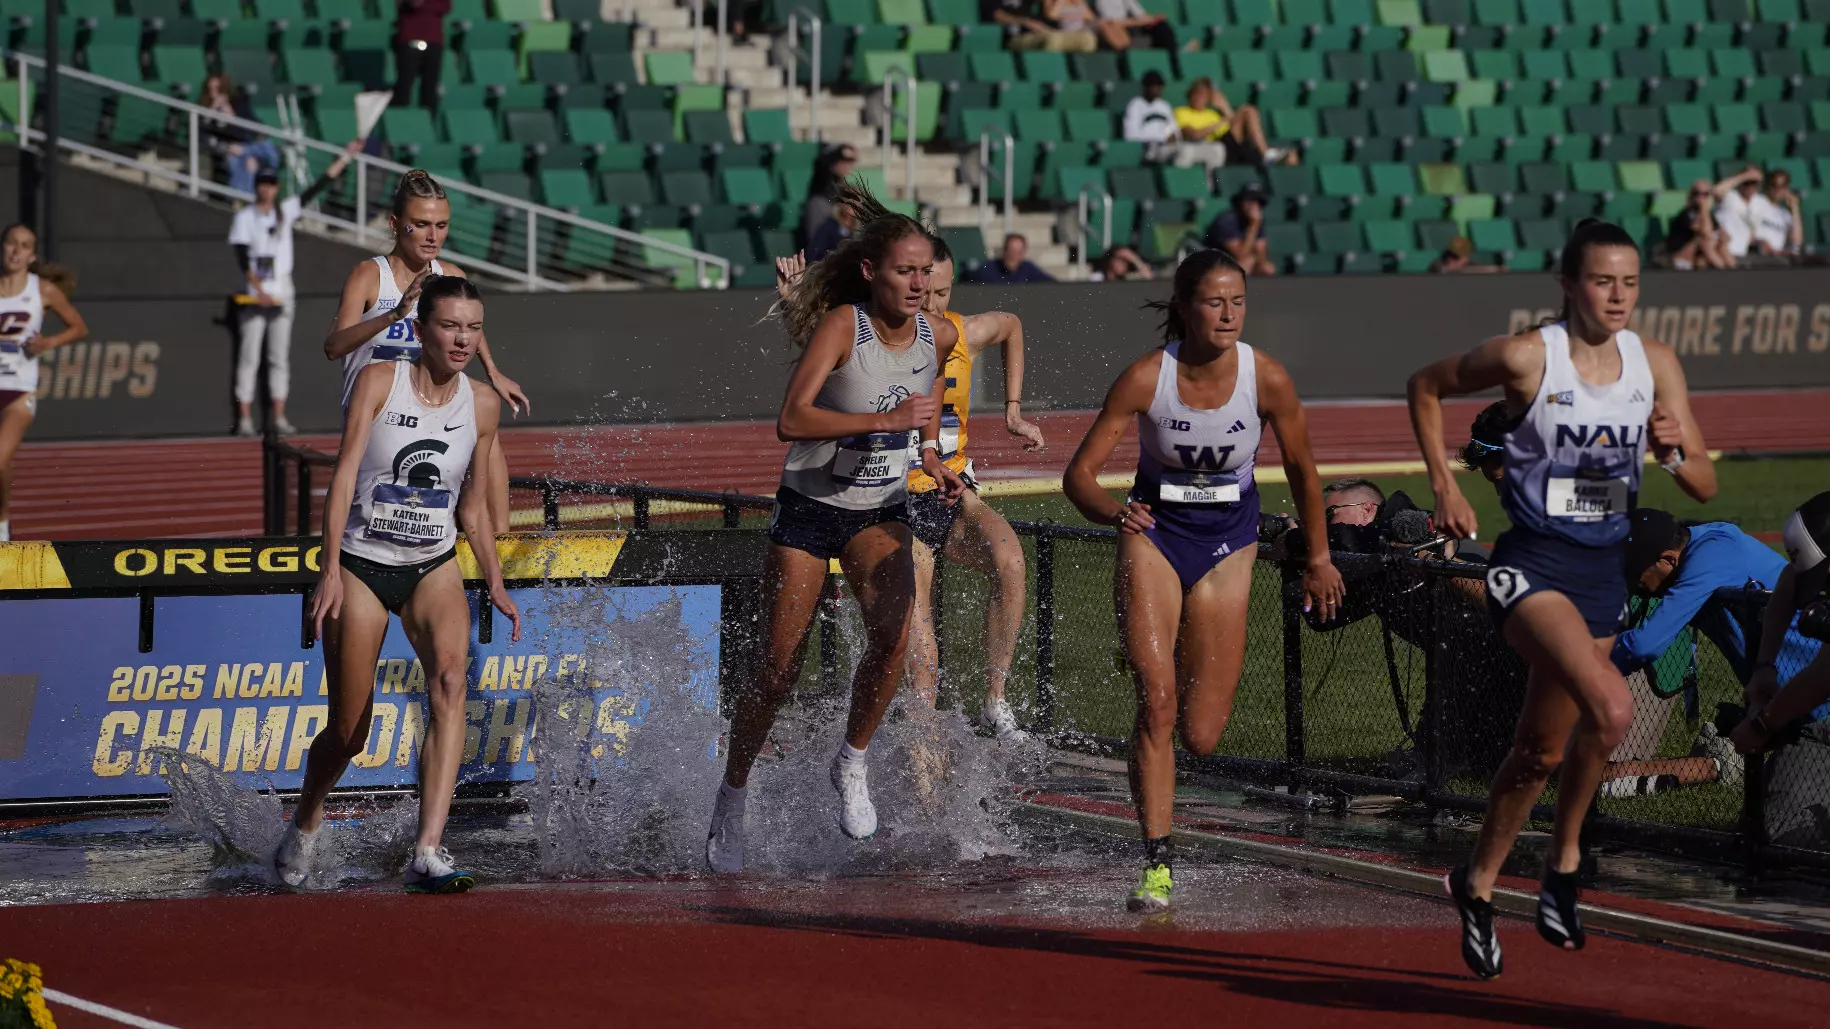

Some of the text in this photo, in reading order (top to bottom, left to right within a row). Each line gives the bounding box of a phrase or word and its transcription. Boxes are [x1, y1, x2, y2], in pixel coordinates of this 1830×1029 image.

[386, 318, 416, 342] BY
[1732, 303, 1801, 355] FOR
[1808, 303, 1830, 353] S
[1556, 424, 1643, 449] NAU
[859, 455, 888, 465] SHELBY
[1173, 444, 1235, 470] W
[849, 465, 890, 478] JENSEN
[1183, 491, 1218, 501] MAGGIE
[372, 517, 444, 537] STEWART-BARNETT
[392, 509, 430, 523] KATELYN
[1493, 568, 1517, 600] 9
[107, 664, 207, 702] 2025
[213, 661, 304, 699] NCAA
[476, 654, 549, 691] AND
